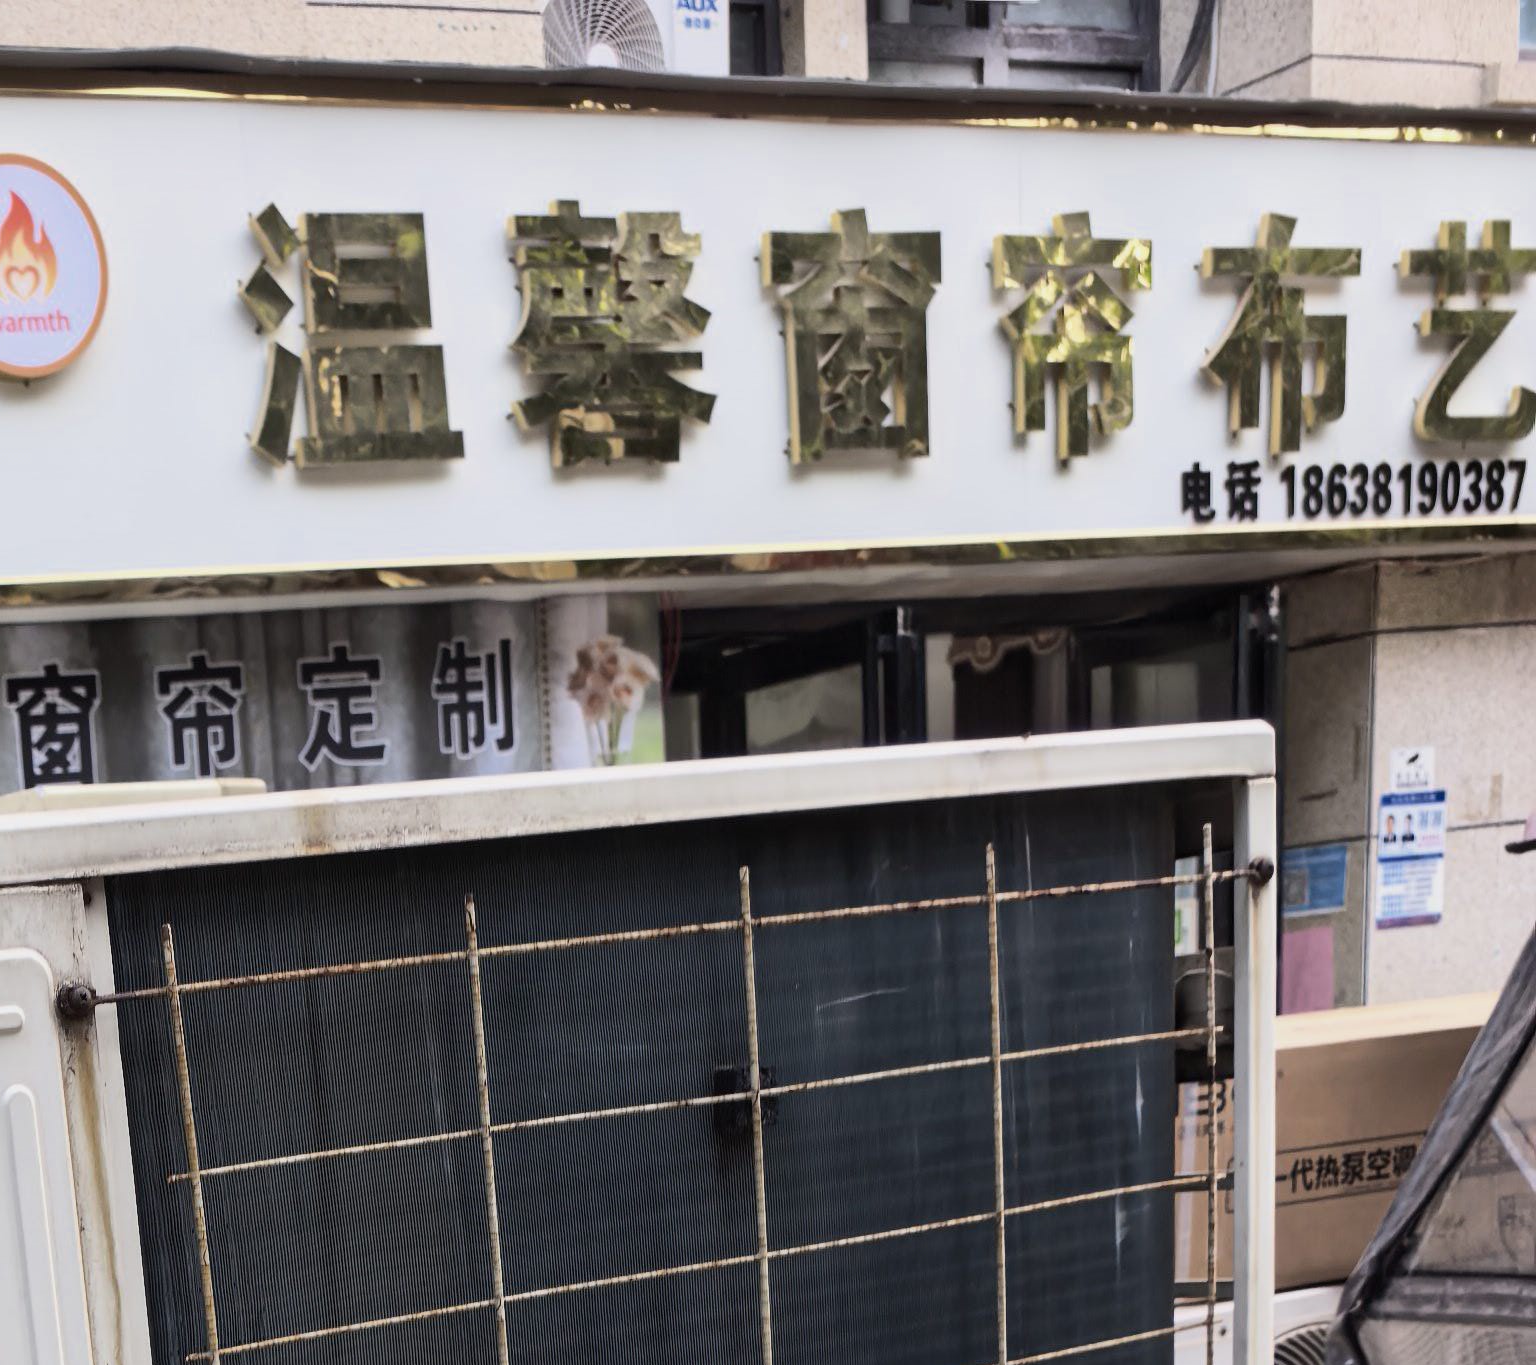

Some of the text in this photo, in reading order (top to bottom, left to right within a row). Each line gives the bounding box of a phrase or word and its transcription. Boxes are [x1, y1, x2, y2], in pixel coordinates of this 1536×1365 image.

[237, 200, 1536, 468] 温馨窗帘布艺
[1180, 458, 1528, 523] 电话 18638190387
[5, 637, 515, 786] 窗帘定制
